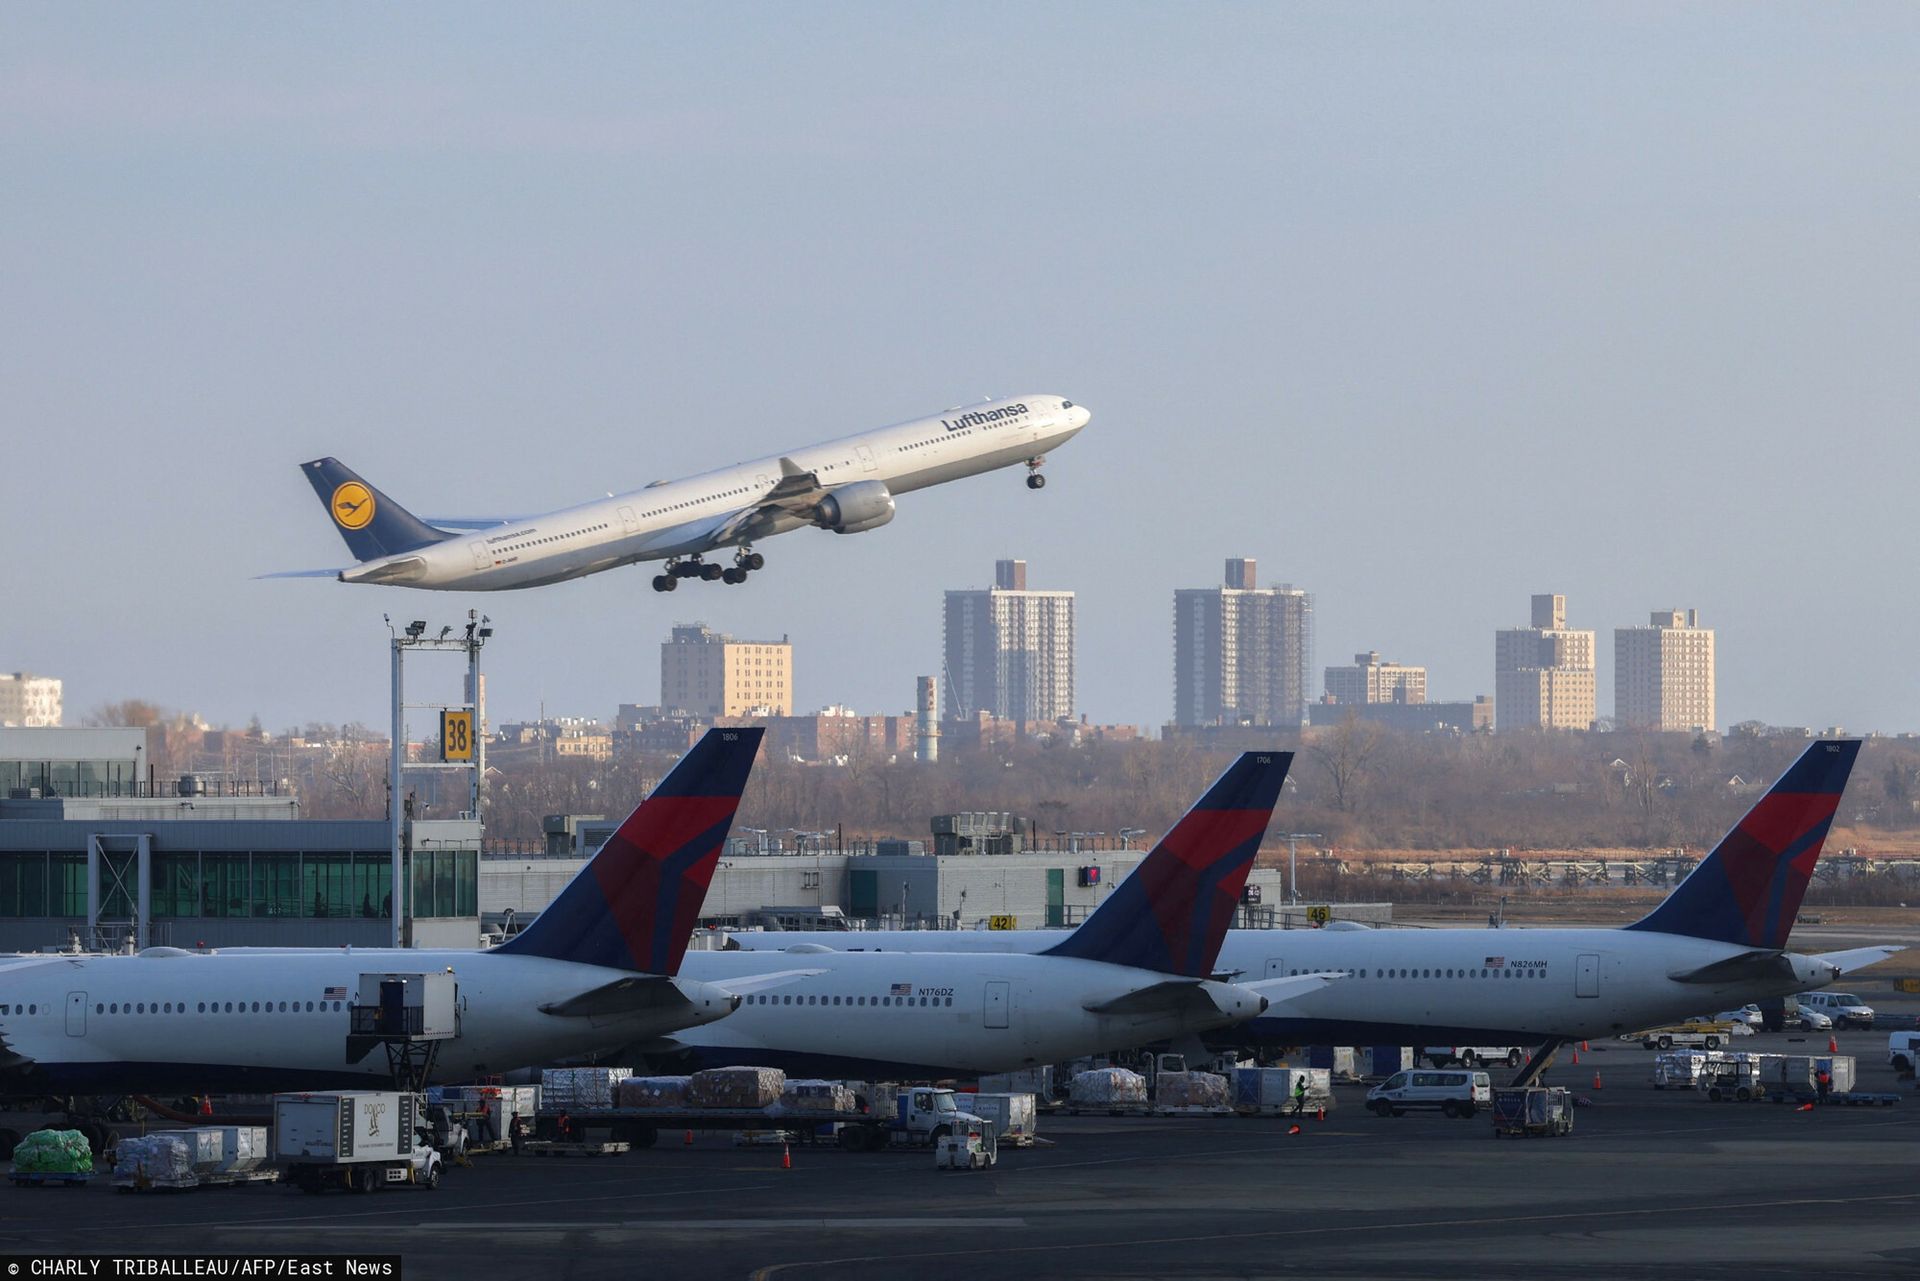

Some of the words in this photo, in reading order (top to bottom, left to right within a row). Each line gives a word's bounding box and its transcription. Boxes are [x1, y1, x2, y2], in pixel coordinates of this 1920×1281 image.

[941, 403, 1029, 432] Lufthansa
[448, 719, 467, 752] 38
[722, 732, 739, 741] 1806
[1256, 756, 1271, 765] 1706
[1310, 908, 1326, 920] 46
[994, 917, 1008, 930] 42
[1510, 960, 1548, 969] N826MH
[918, 987, 954, 997] N176DZ
